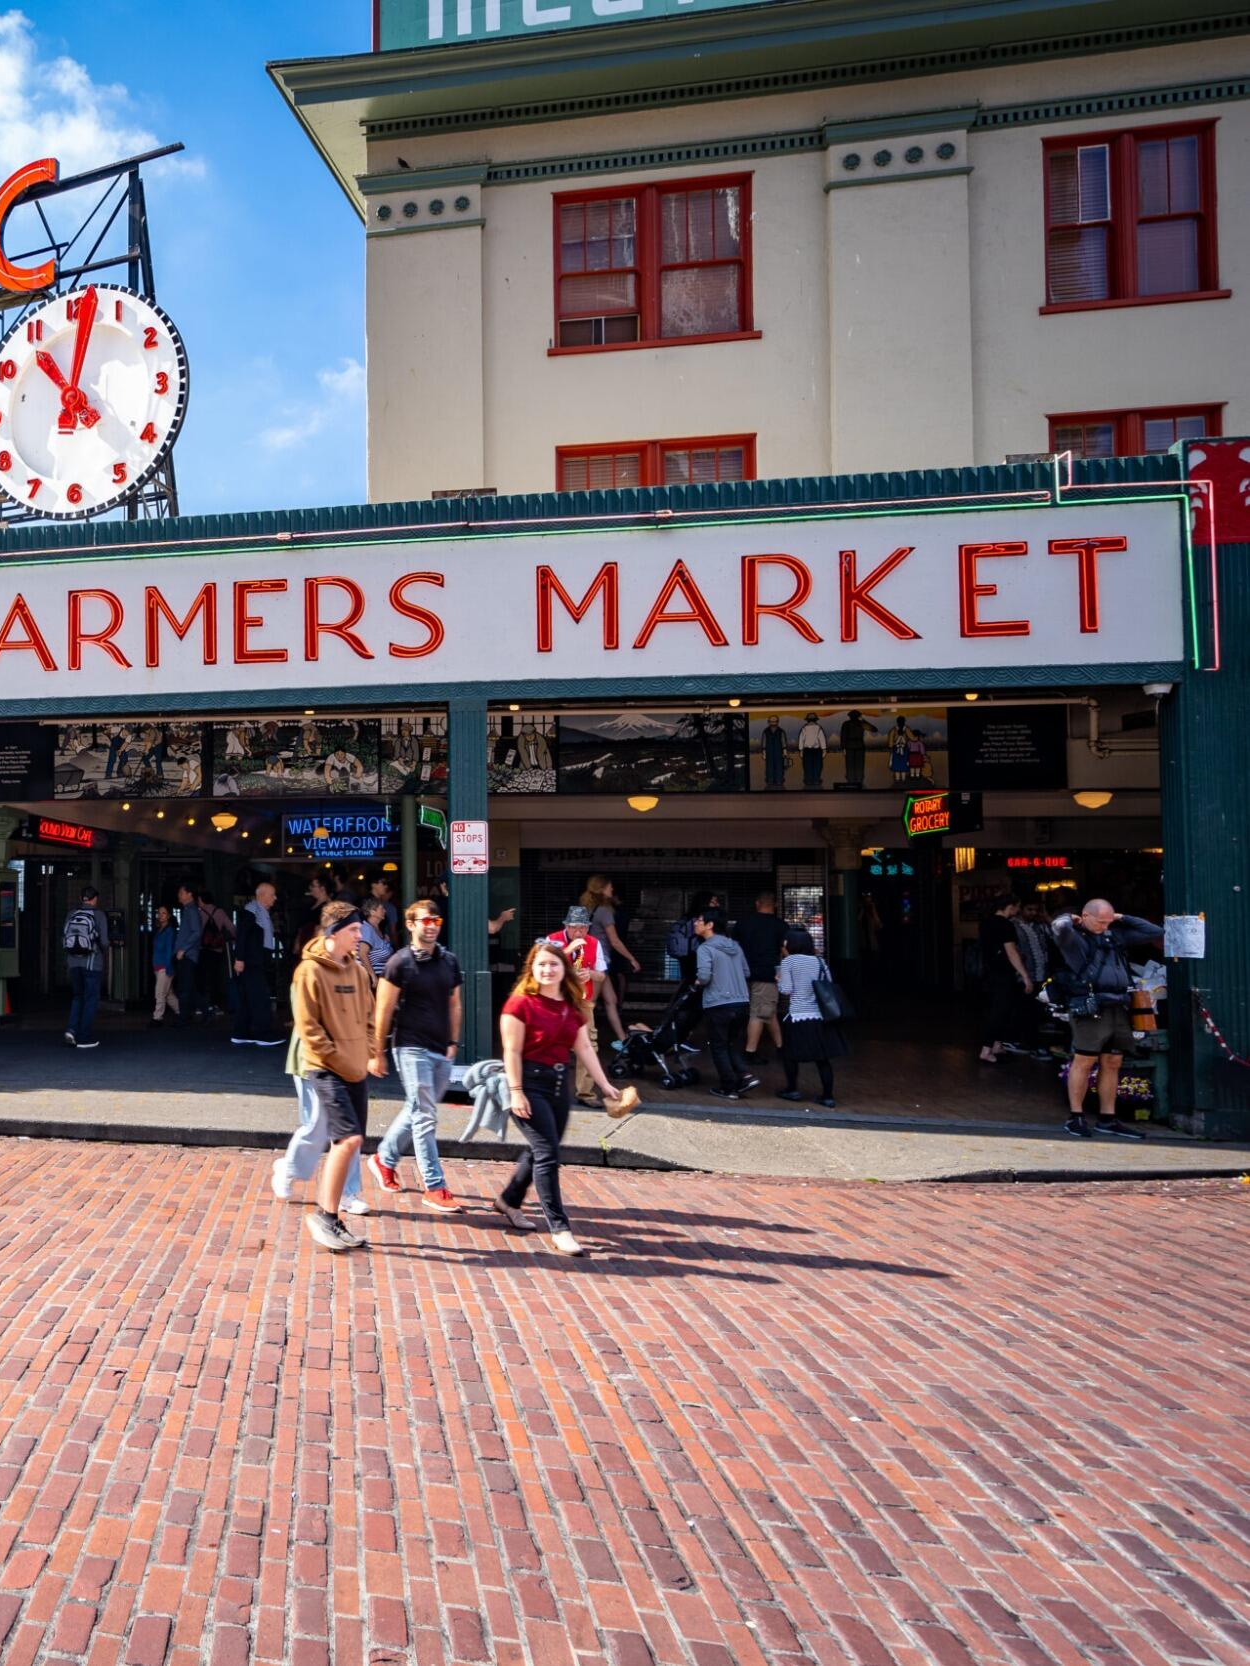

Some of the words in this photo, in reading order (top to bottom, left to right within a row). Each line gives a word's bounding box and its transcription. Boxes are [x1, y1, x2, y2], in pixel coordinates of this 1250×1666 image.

[115, 300, 122, 322] 1
[27, 319, 43, 343] 11
[143, 327, 158, 349] 2
[154, 372, 168, 394] 3
[140, 422, 157, 443] 4
[112, 462, 127, 484] 5
[27, 478, 42, 499] 7
[67, 483, 82, 504] 6
[536, 535, 1128, 654] MARKET
[914, 797, 942, 815] ROTARY
[39, 820, 61, 836] OUND
[288, 816, 400, 835] WATERFRON
[453, 824, 463, 832] NO
[909, 812, 950, 833] GROCERY
[303, 836, 388, 849] VIEWPOINT
[456, 834, 483, 843] STOPS
